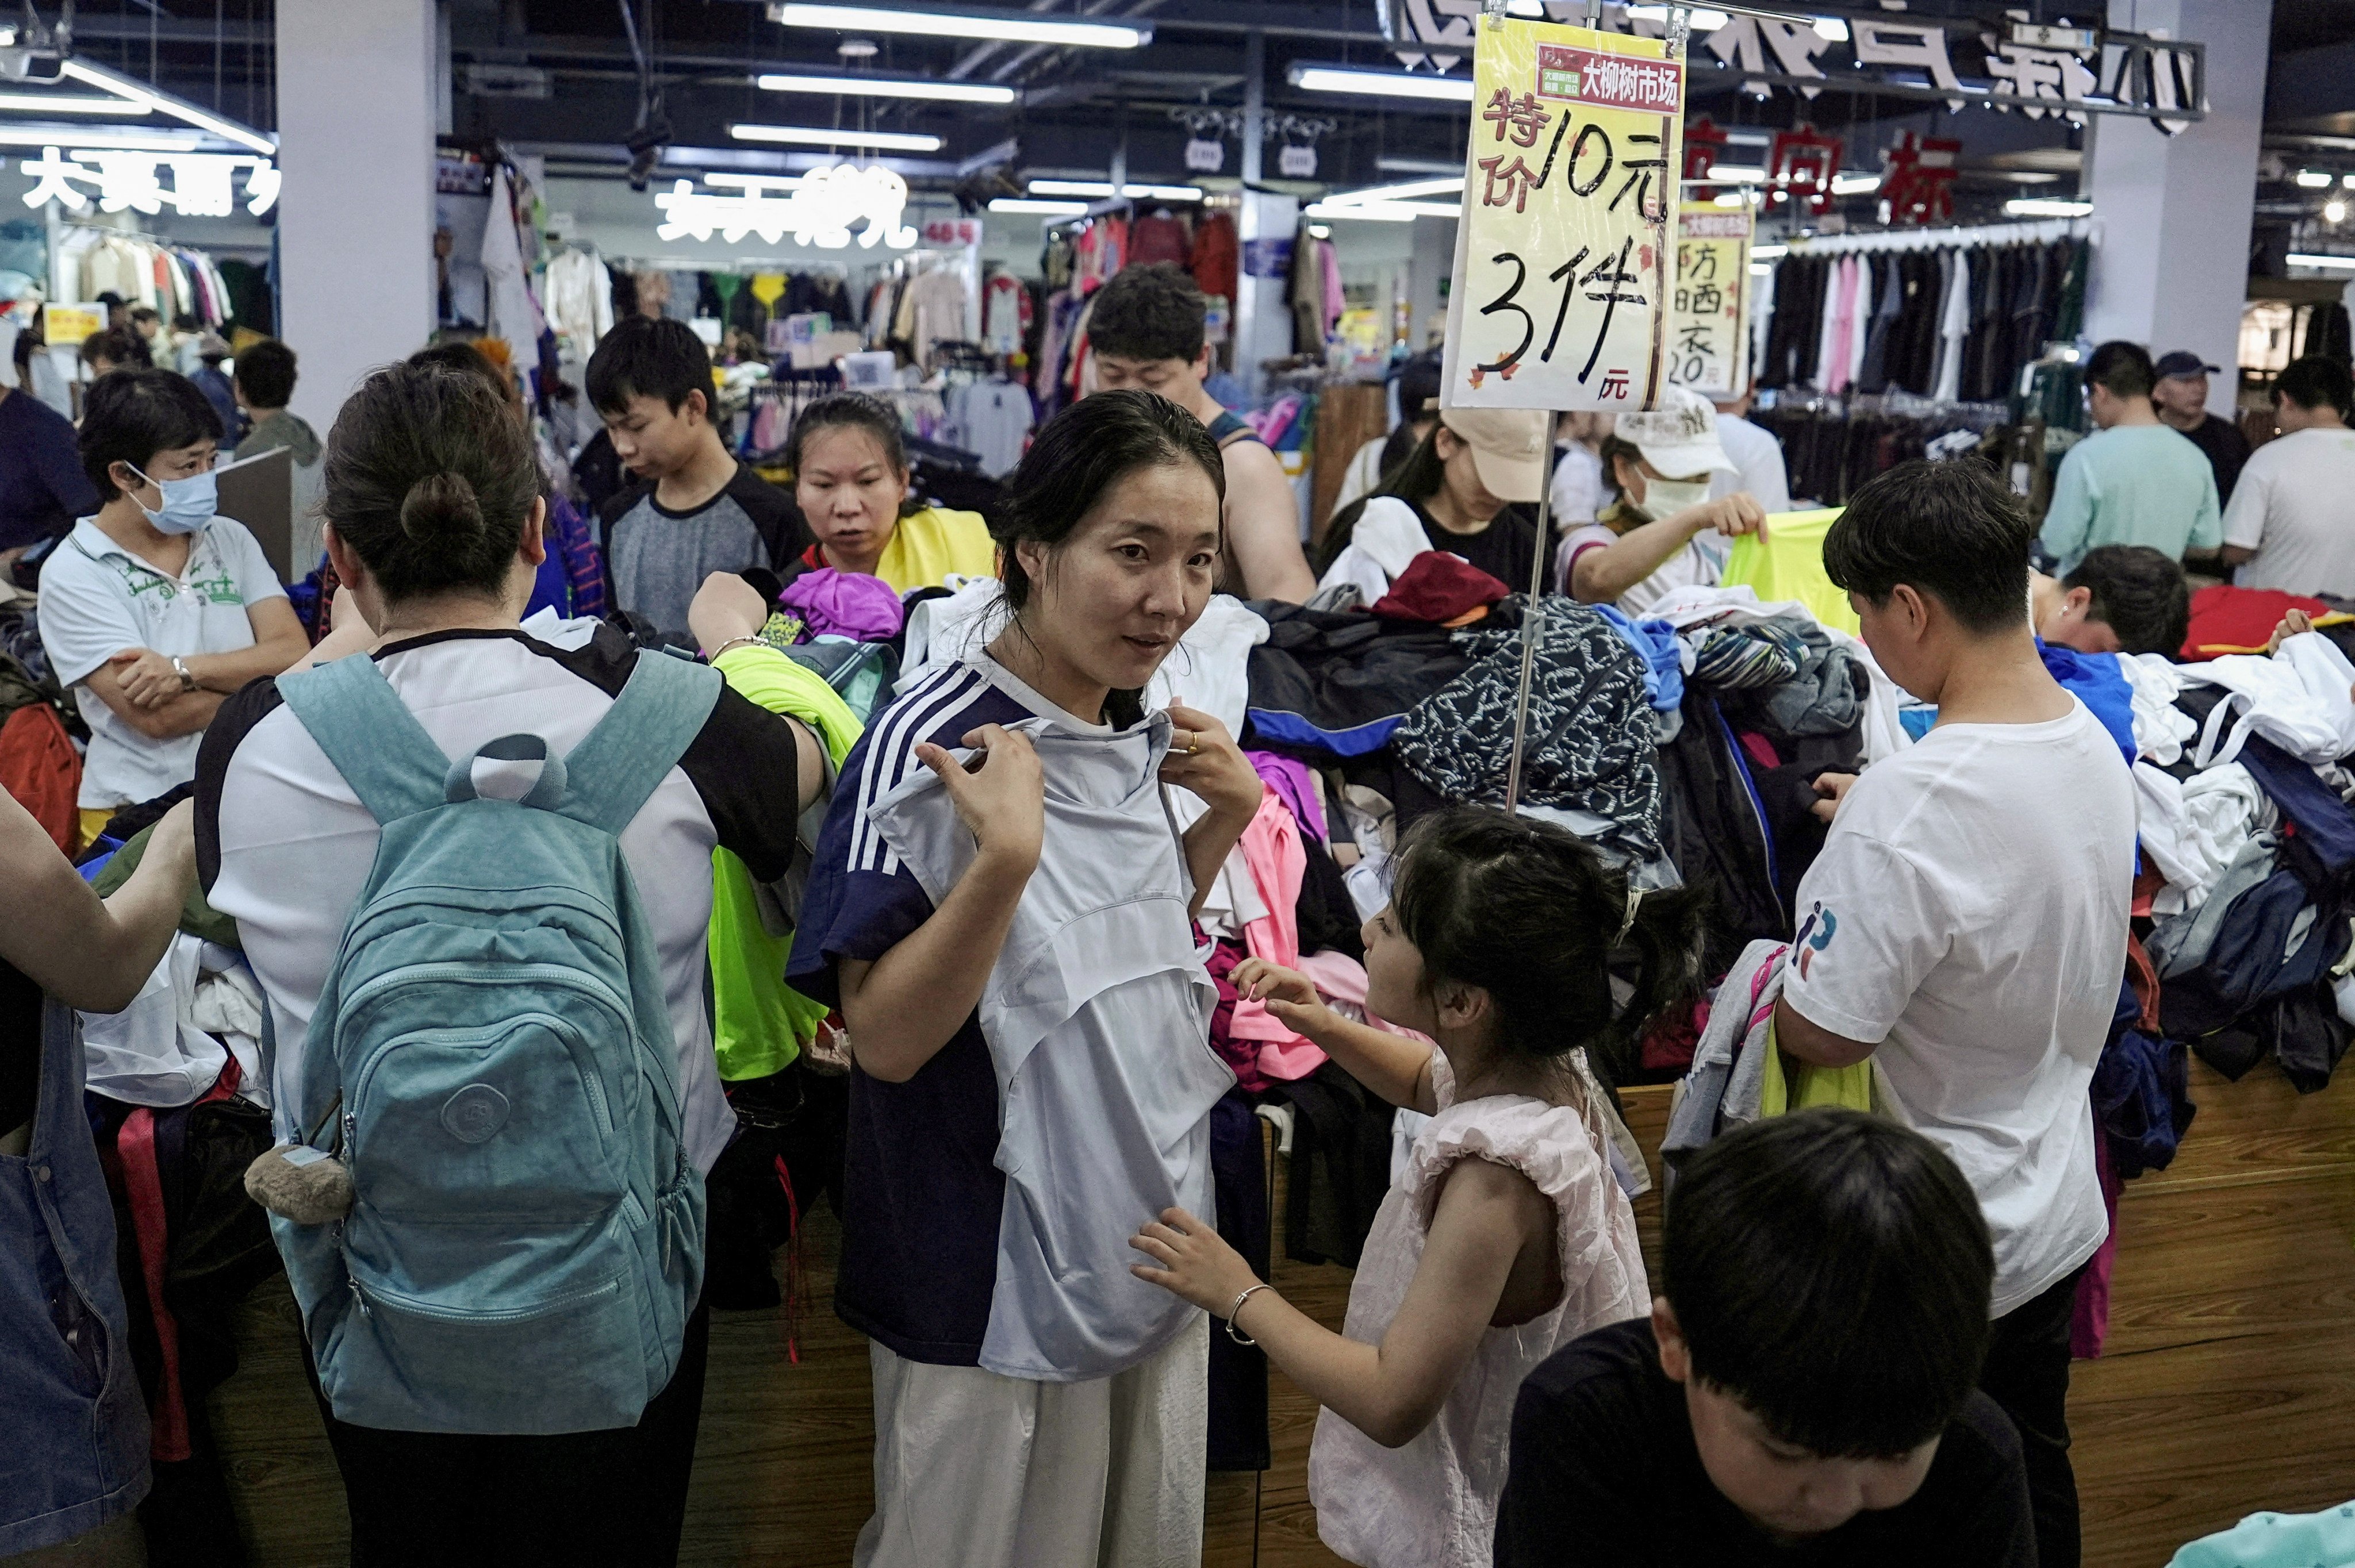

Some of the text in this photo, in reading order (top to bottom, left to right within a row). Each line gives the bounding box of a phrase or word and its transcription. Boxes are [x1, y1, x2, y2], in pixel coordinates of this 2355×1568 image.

[1582, 57, 1678, 107] 大柳树市场
[1478, 86, 1552, 214] 特价
[1536, 108, 1667, 224] 10元
[1476, 235, 1648, 385] 3件
[1598, 369, 1629, 401] 元
